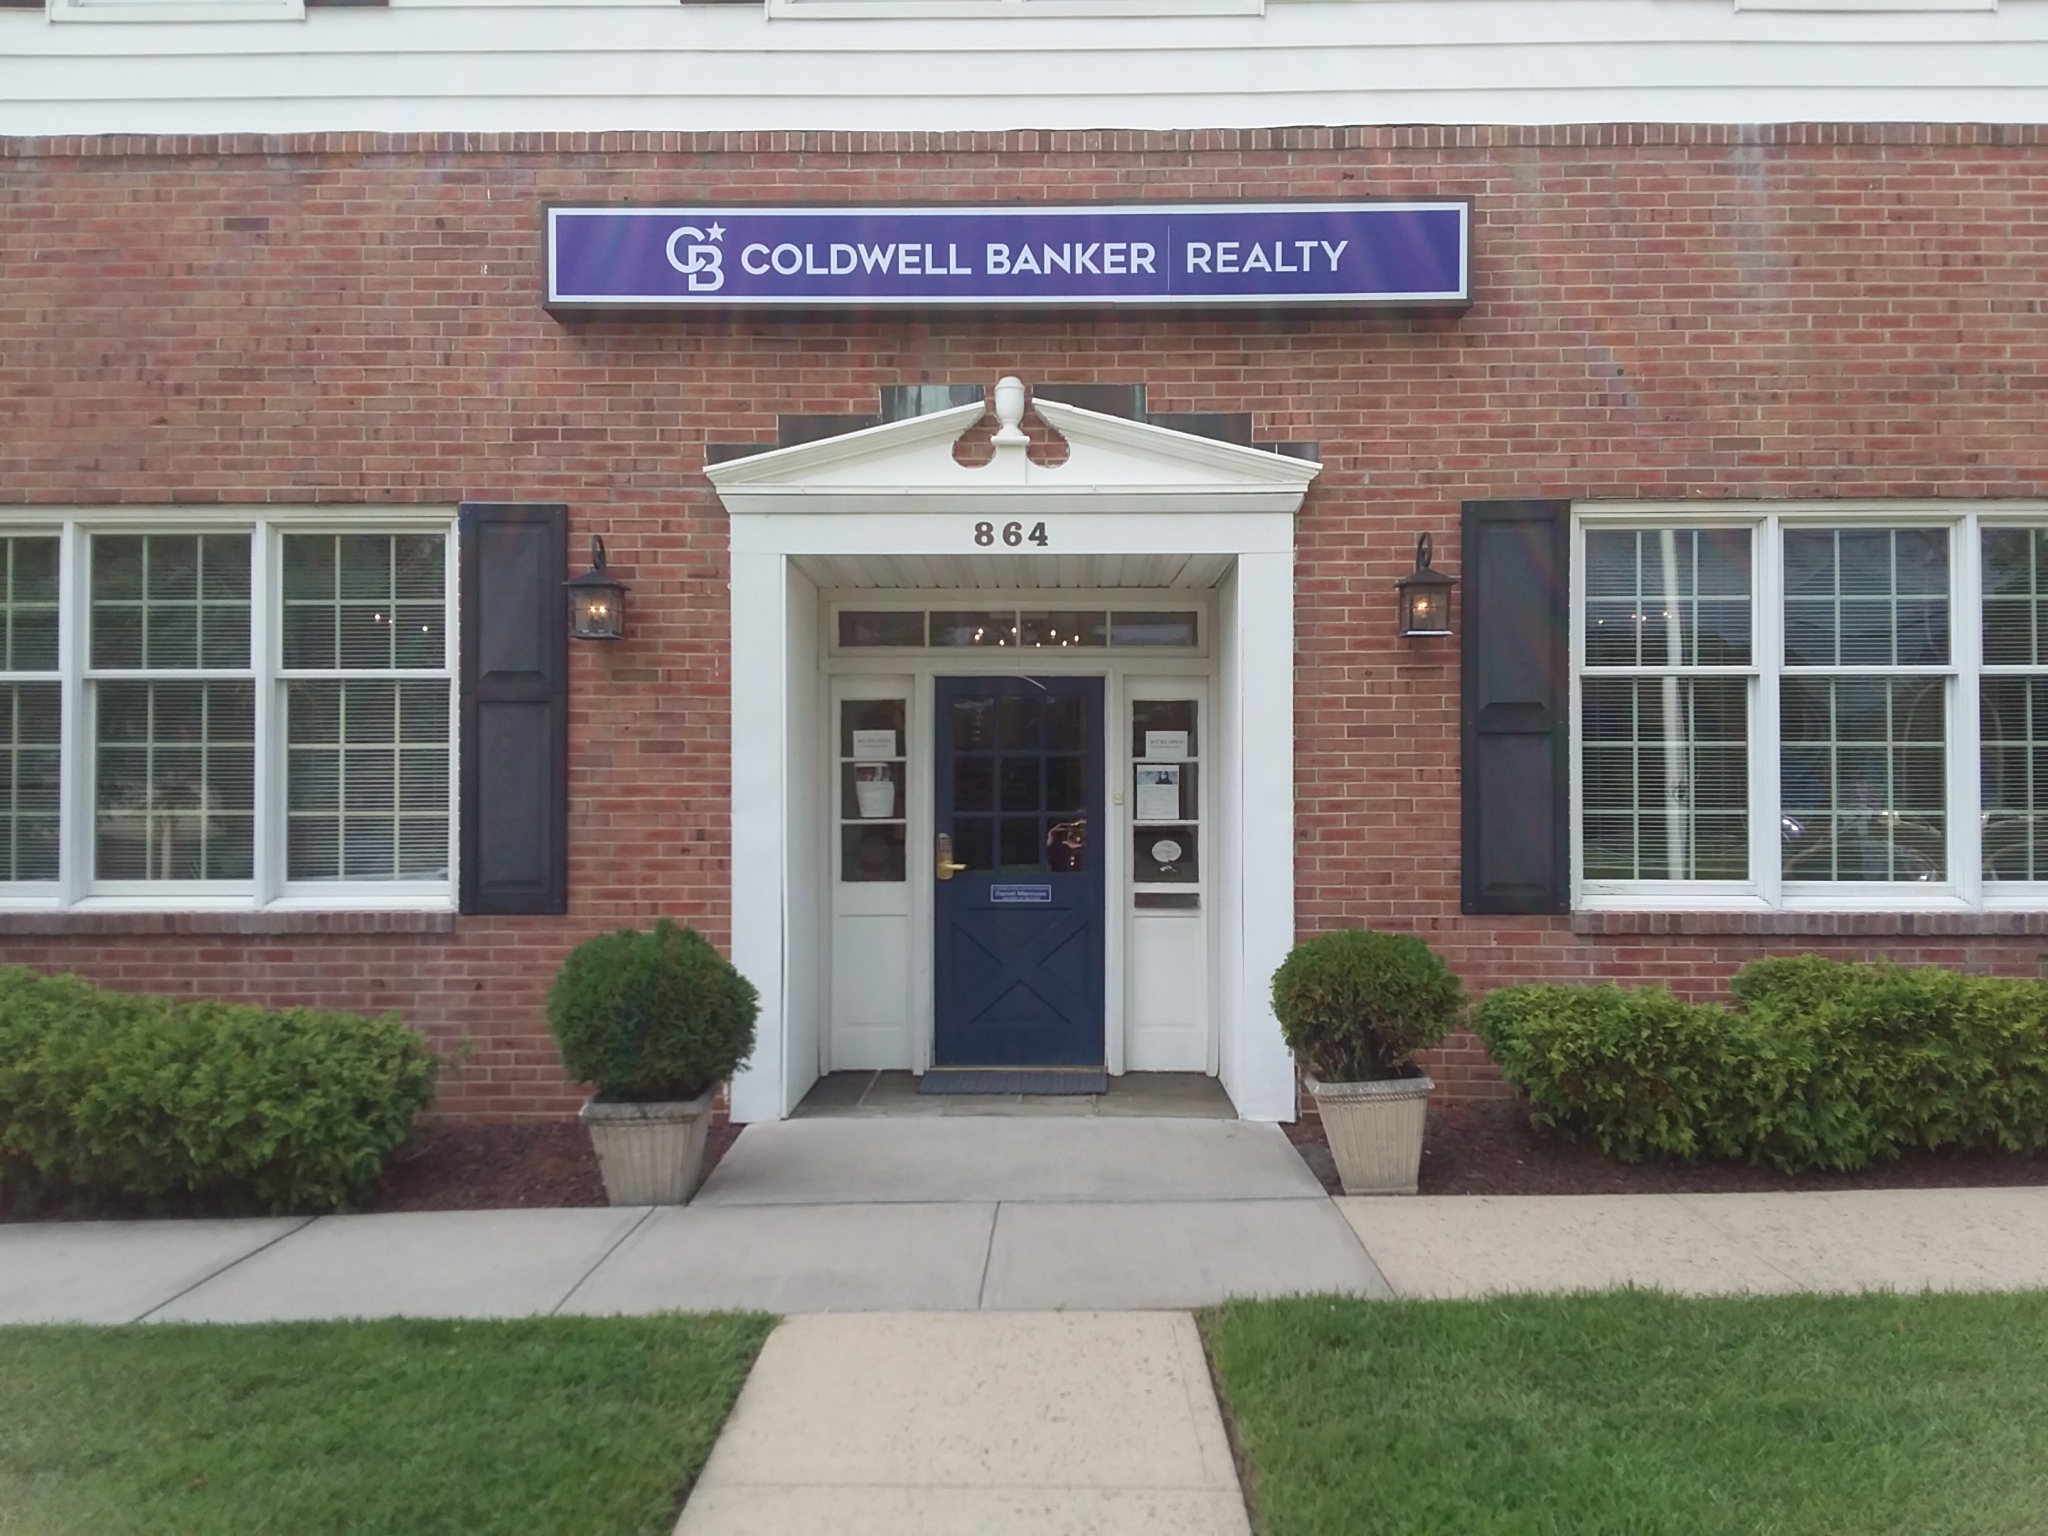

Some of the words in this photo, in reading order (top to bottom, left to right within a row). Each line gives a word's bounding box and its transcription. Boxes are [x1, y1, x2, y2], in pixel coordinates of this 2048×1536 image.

[666, 226, 725, 292] CB
[741, 243, 972, 275] COLDWELL
[986, 242, 1156, 275] BANKER
[1187, 240, 1348, 274] REALTY
[974, 521, 1048, 547] 864
